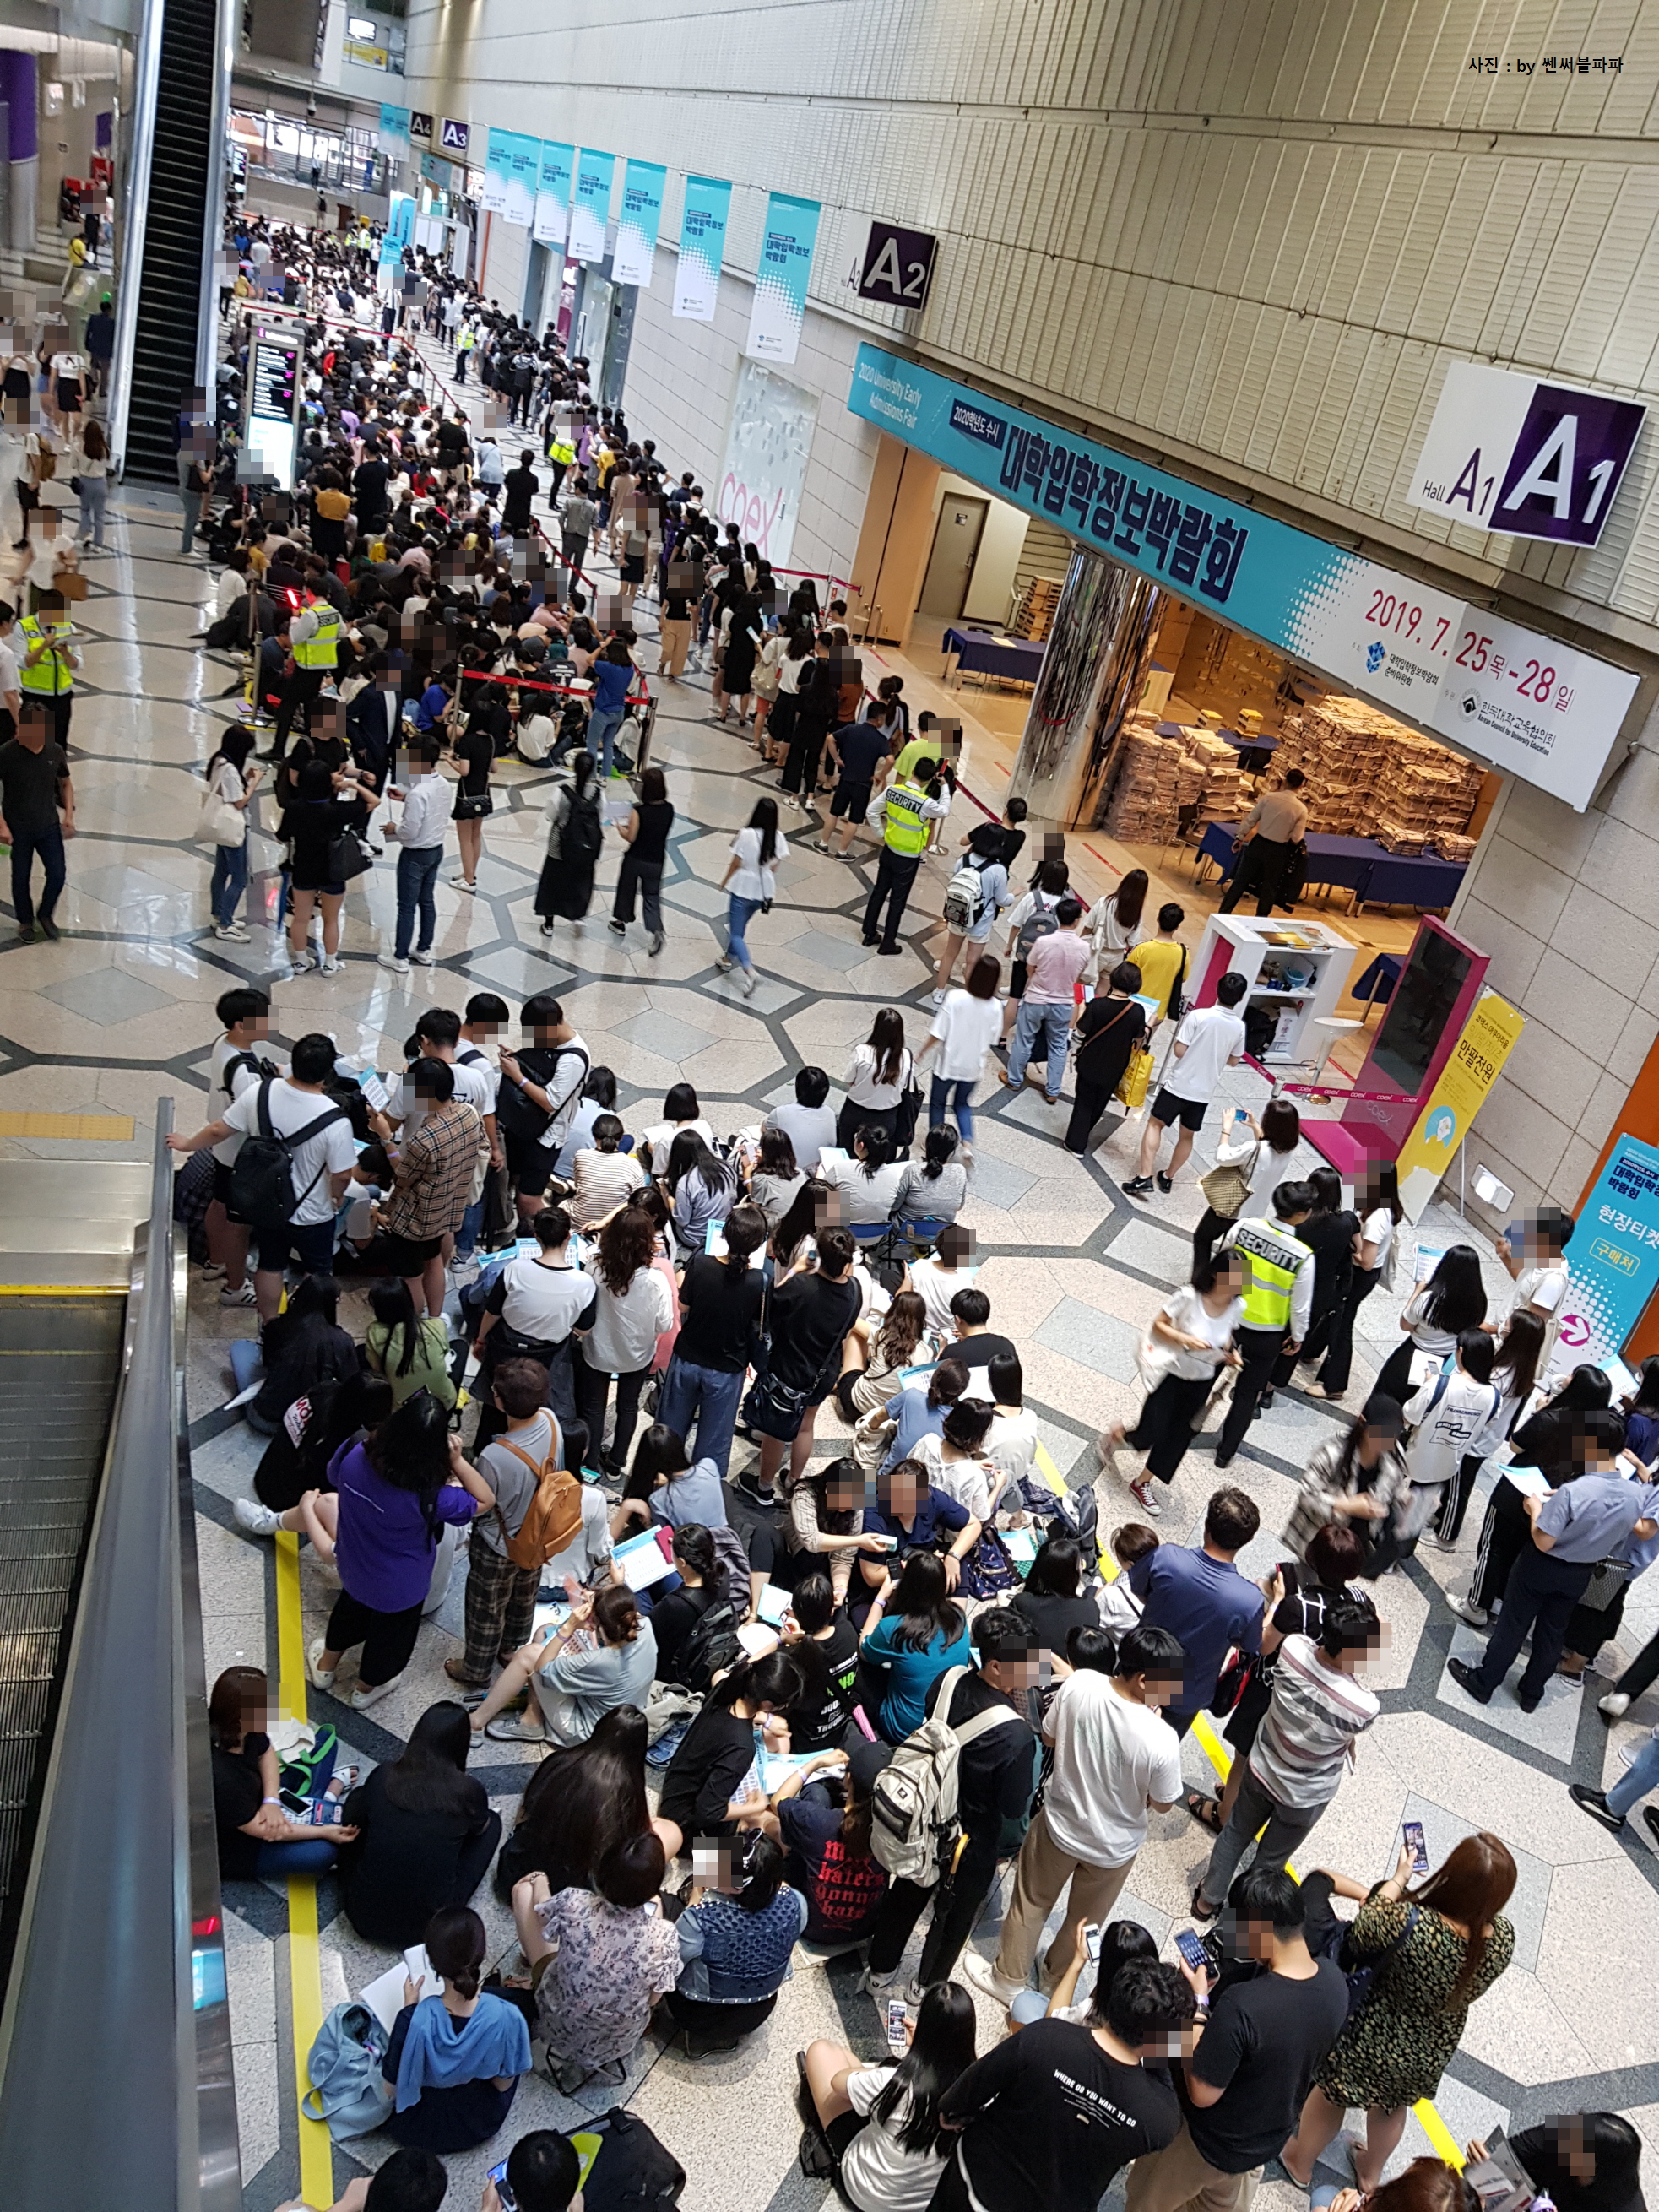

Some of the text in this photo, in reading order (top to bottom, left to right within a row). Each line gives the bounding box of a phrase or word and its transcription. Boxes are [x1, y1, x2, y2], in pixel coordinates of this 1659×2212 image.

[411, 115, 431, 136] A4
[443, 124, 467, 147] A3
[863, 237, 926, 299] A2
[858, 362, 923, 409] 2020 University Early
[869, 392, 919, 430] Admissions Fair
[953, 406, 1000, 442] 2020학년도 수시
[1422, 447, 1496, 516] Hall A1
[1502, 414, 1617, 524] A1
[999, 424, 1250, 604] 대학입학정보박람회
[1389, 653, 1439, 686] 대학입학정보박람회
[1477, 714, 1491, 726] Korean
[1490, 721, 1505, 733] Council
[1510, 730, 1530, 747] University
[1529, 740, 1550, 756] Education
[1480, 702, 1557, 748] 한국대학교육협의회
[886, 790, 921, 813] SECURITY
[1457, 1039, 1496, 1085] 만팔천원
[1607, 1177, 1640, 1200] 박람회
[1237, 1230, 1300, 1272] SECURITY
[1597, 1242, 1635, 1271] 구매처
[1054, 2068, 1136, 2128] WHERE DO YOU WANT TO GO
